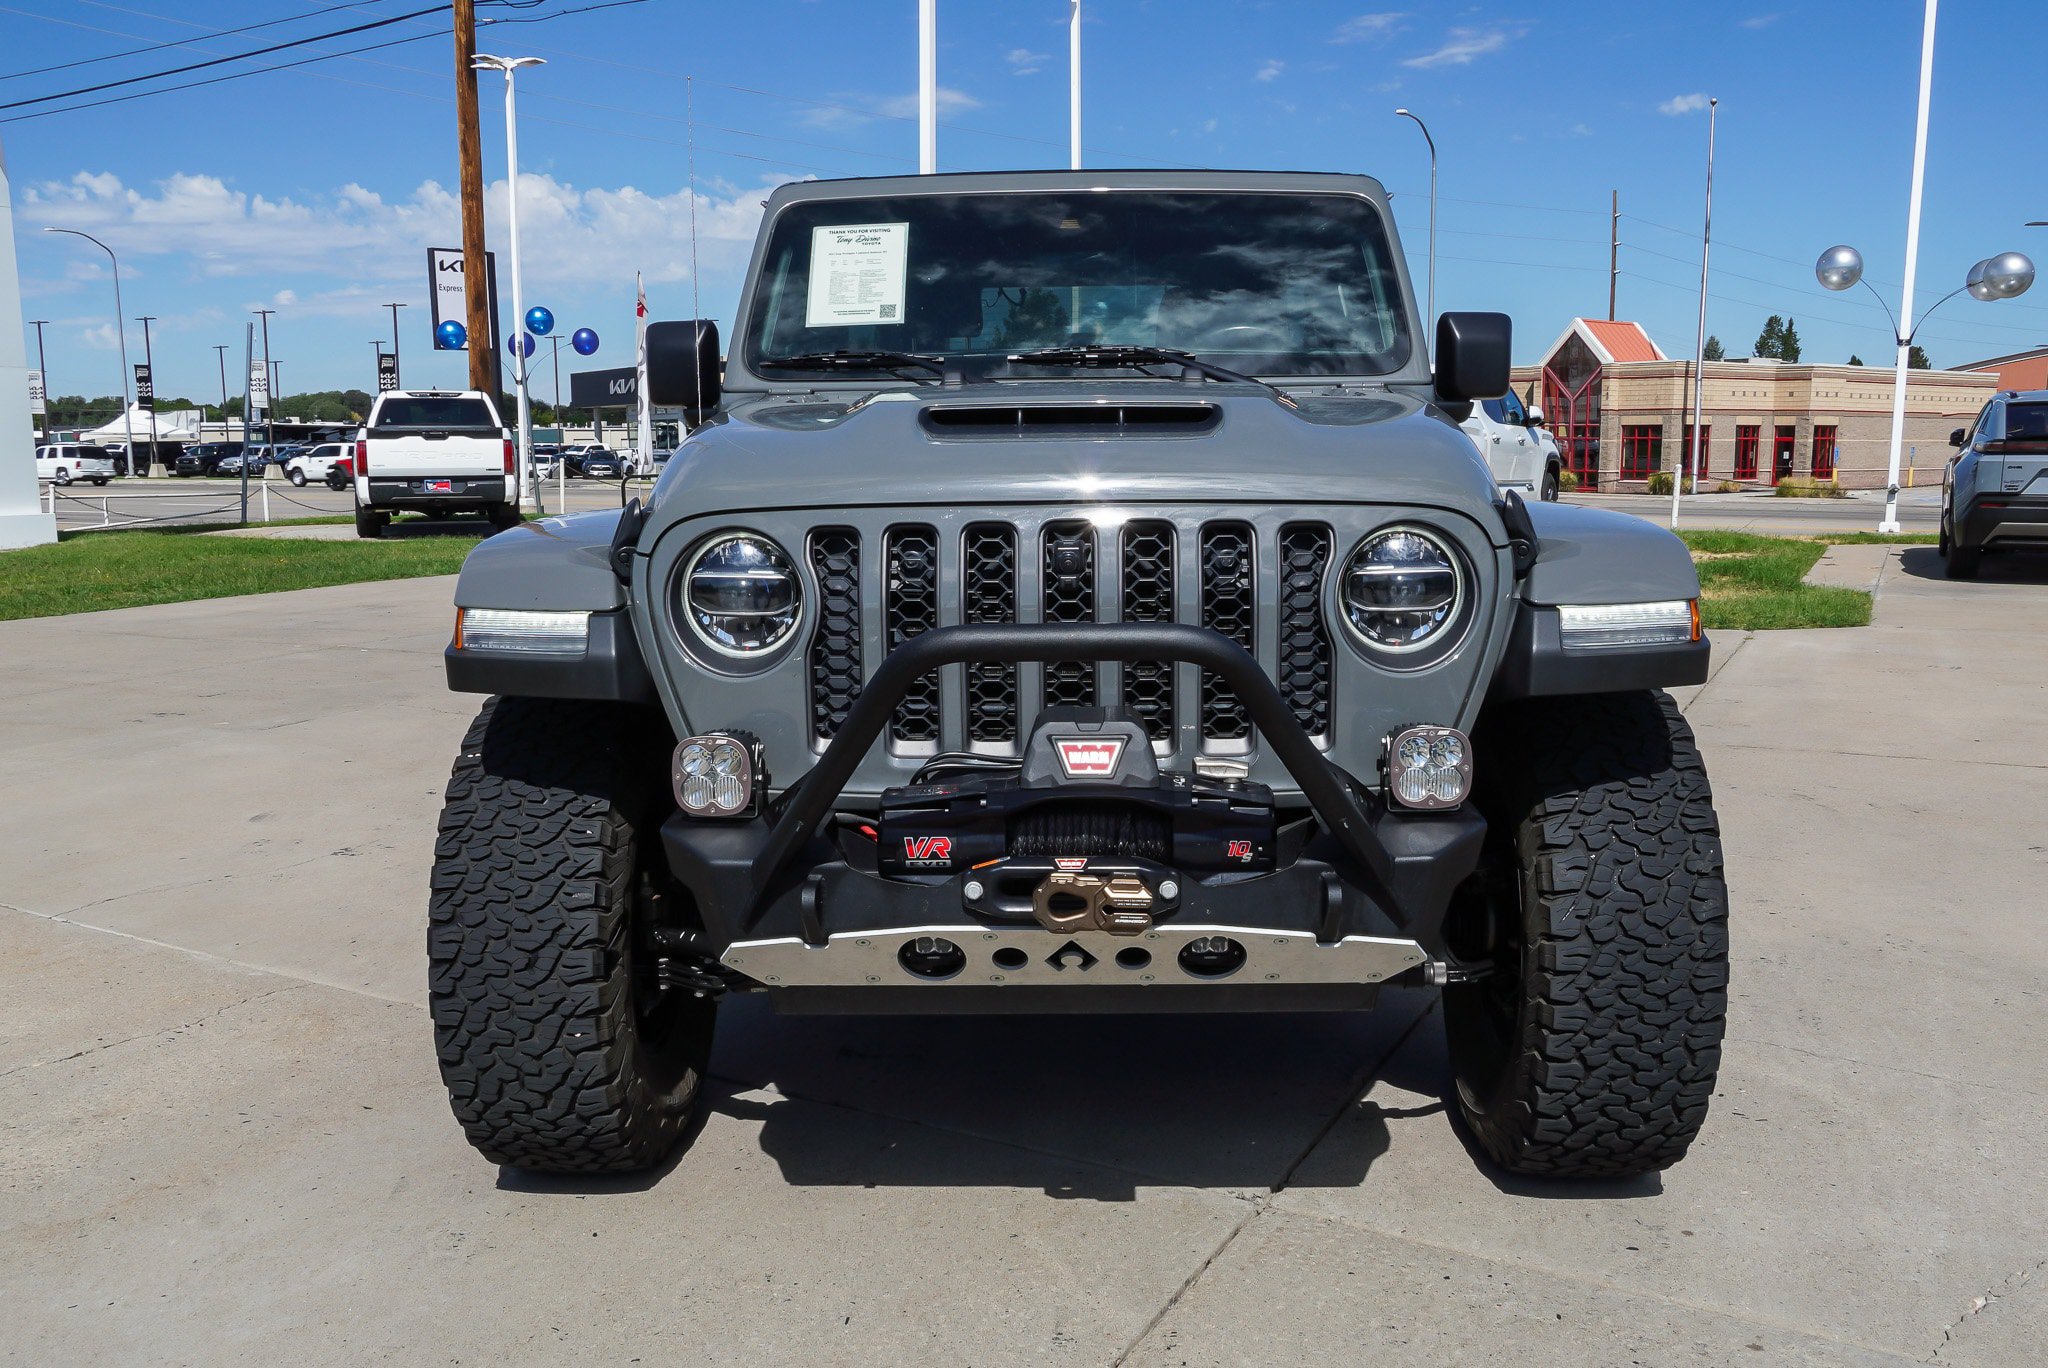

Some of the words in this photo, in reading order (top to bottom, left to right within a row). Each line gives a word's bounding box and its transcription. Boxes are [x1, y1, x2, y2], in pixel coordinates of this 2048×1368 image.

[439, 259, 465, 273] KI
[438, 283, 463, 293] Express
[1068, 751, 1110, 765] WARN
[904, 836, 952, 859] VR
[1228, 840, 1252, 857] 10
[907, 860, 951, 868] EVO
